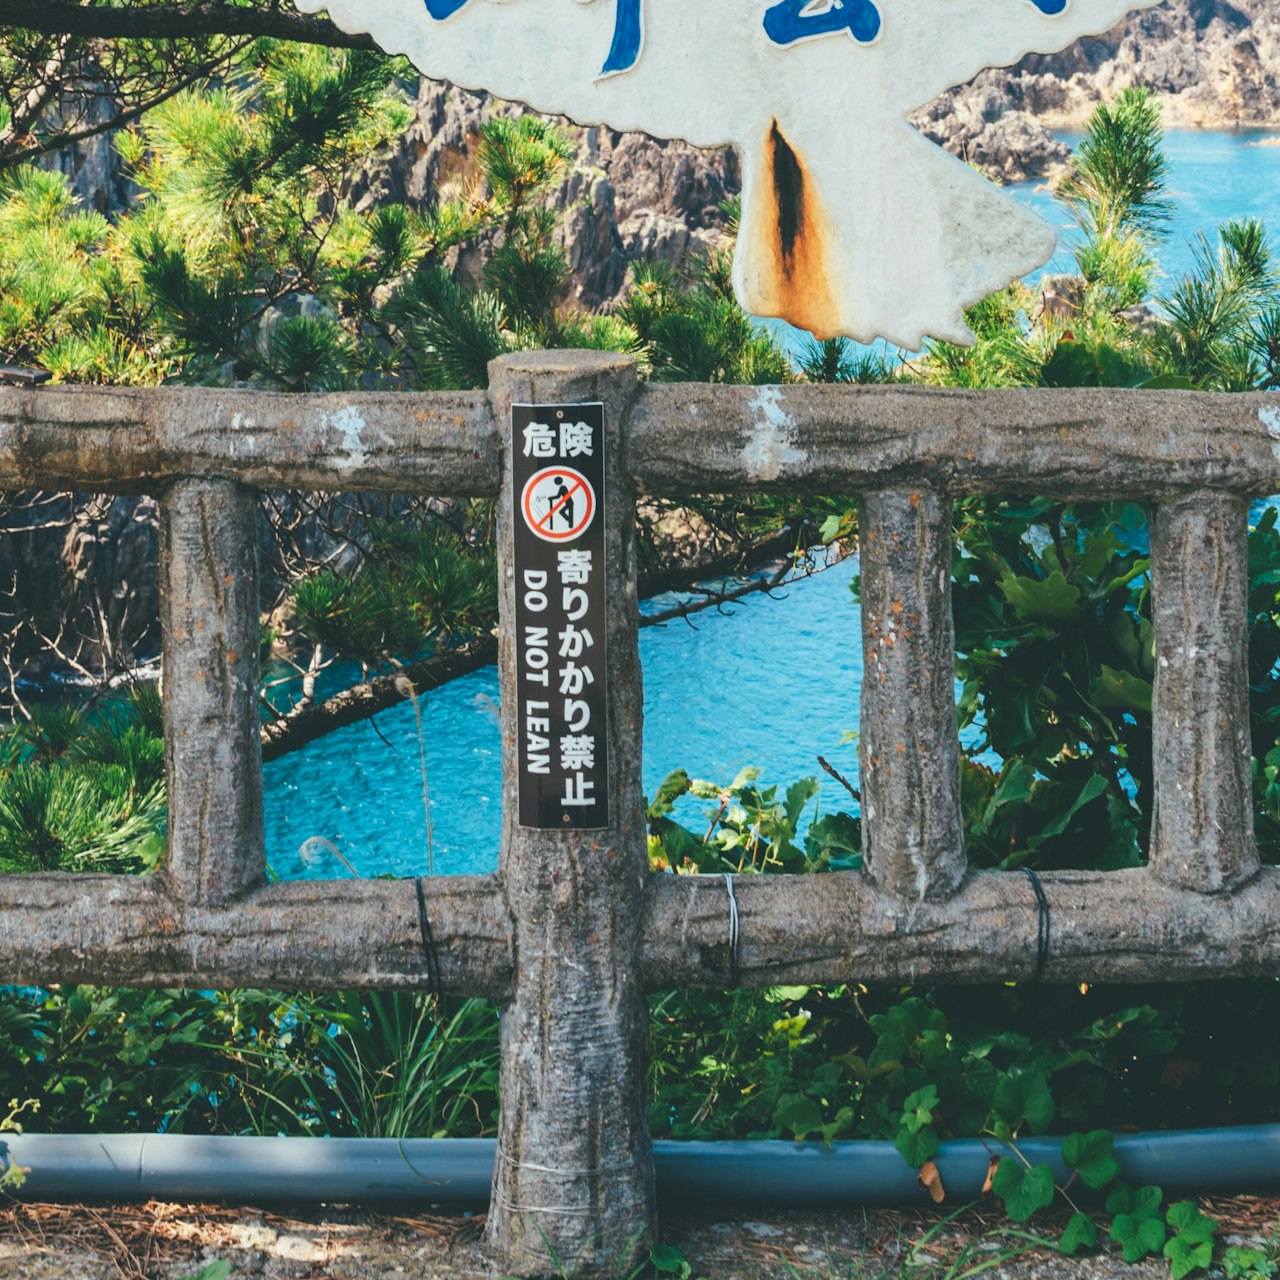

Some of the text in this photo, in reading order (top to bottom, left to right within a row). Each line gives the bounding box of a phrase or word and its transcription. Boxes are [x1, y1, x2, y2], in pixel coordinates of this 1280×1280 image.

[522, 422, 594, 458] 危険
[523, 569, 550, 774] DO NOT LEAN
[557, 549, 596, 806] 寄りかかり禁止
